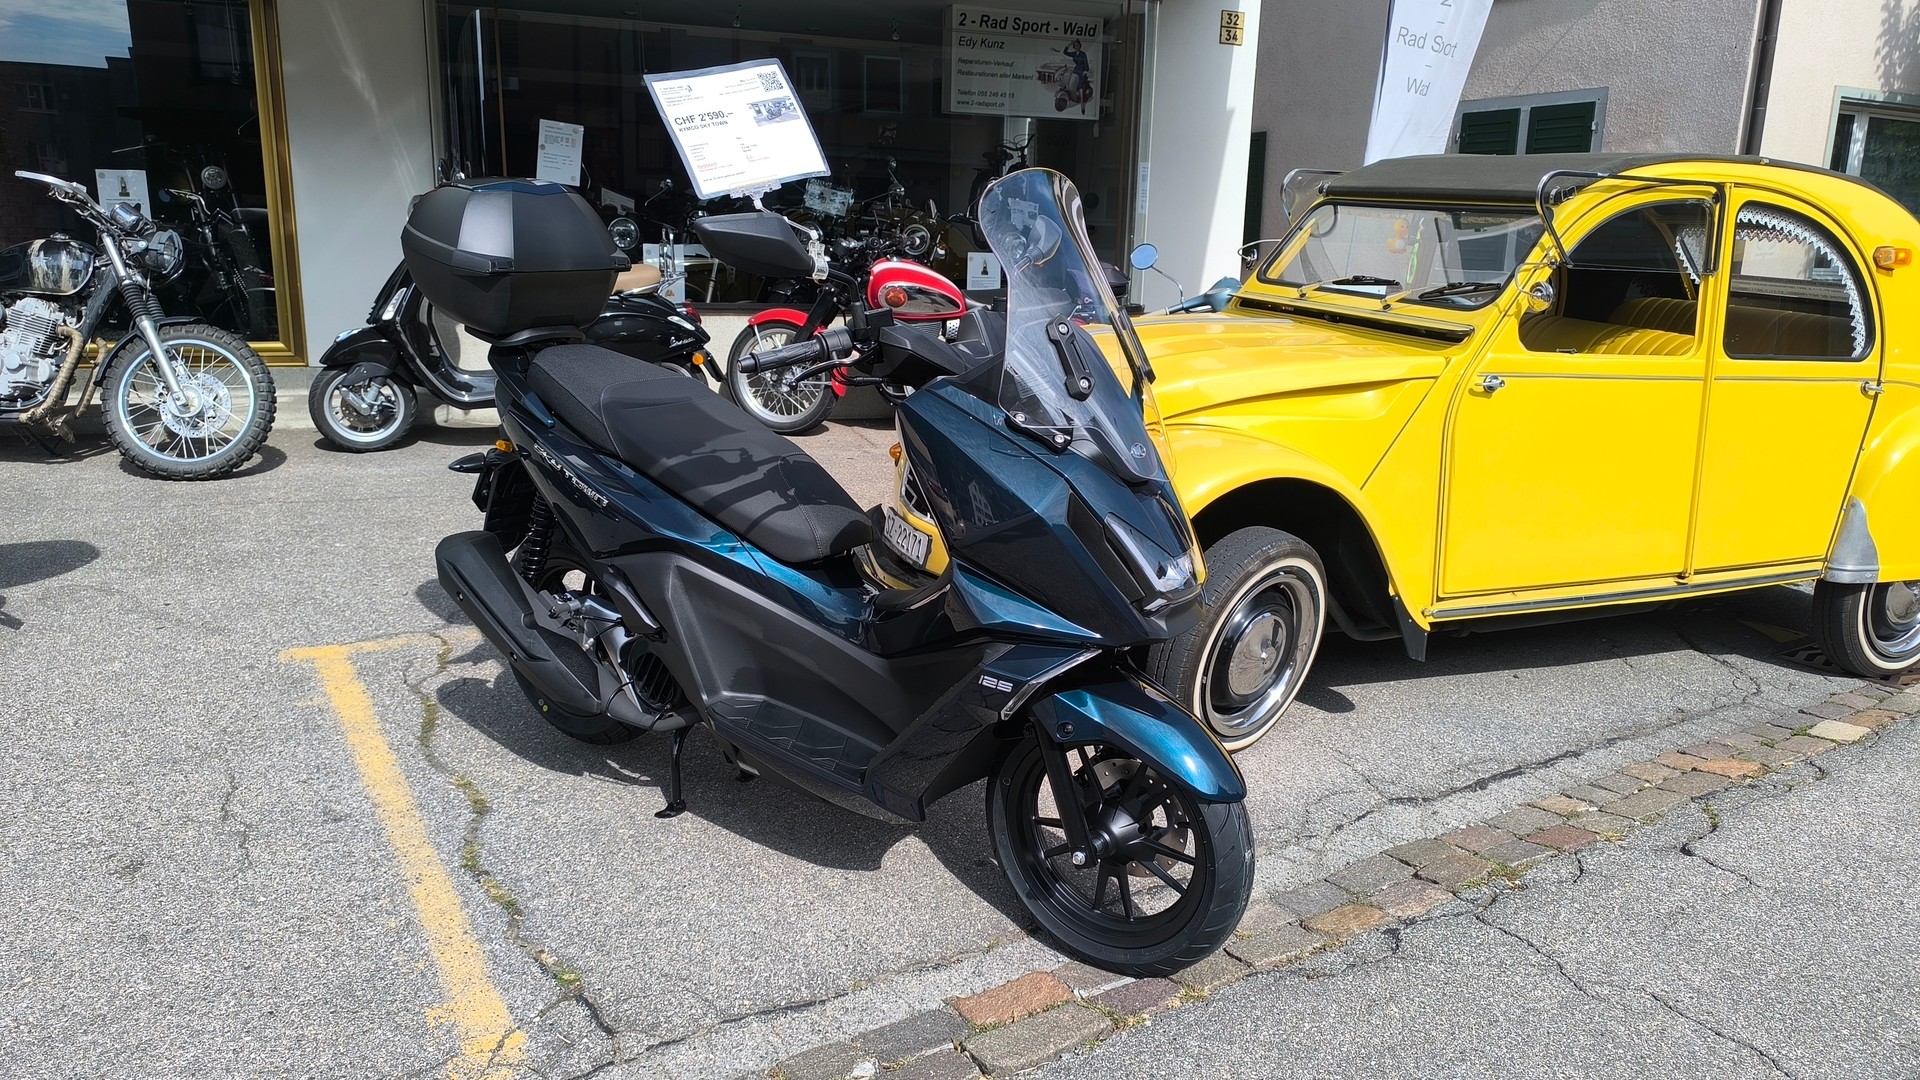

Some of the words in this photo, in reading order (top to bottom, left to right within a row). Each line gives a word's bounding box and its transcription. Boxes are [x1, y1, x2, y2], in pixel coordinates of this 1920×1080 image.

[958, 12, 967, 26] 2
[979, 14, 1009, 30] Rad
[1011, 17, 1051, 35] Sport
[1063, 21, 1097, 37] Wald
[1225, 13, 1240, 26] 32
[1224, 29, 1239, 42] 34
[1396, 26, 1428, 50] Rad
[1431, 35, 1458, 58] Sot
[958, 36, 978, 49] Edy
[980, 38, 1005, 50] Kunz
[957, 57, 1015, 67] Reparaturen-Verkauf
[957, 69, 999, 78] Restaurationen
[999, 71, 1011, 79] aller
[957, 89, 976, 97] Telefon
[1407, 76, 1431, 97] Wad
[956, 100, 1006, 109] www.2-radsport.ch
[674, 114, 696, 126] CHF
[678, 125, 700, 133] KYMCO
[699, 122, 711, 130] SKY
[711, 120, 729, 128] TOWN
[978, 674, 1014, 693] 125
